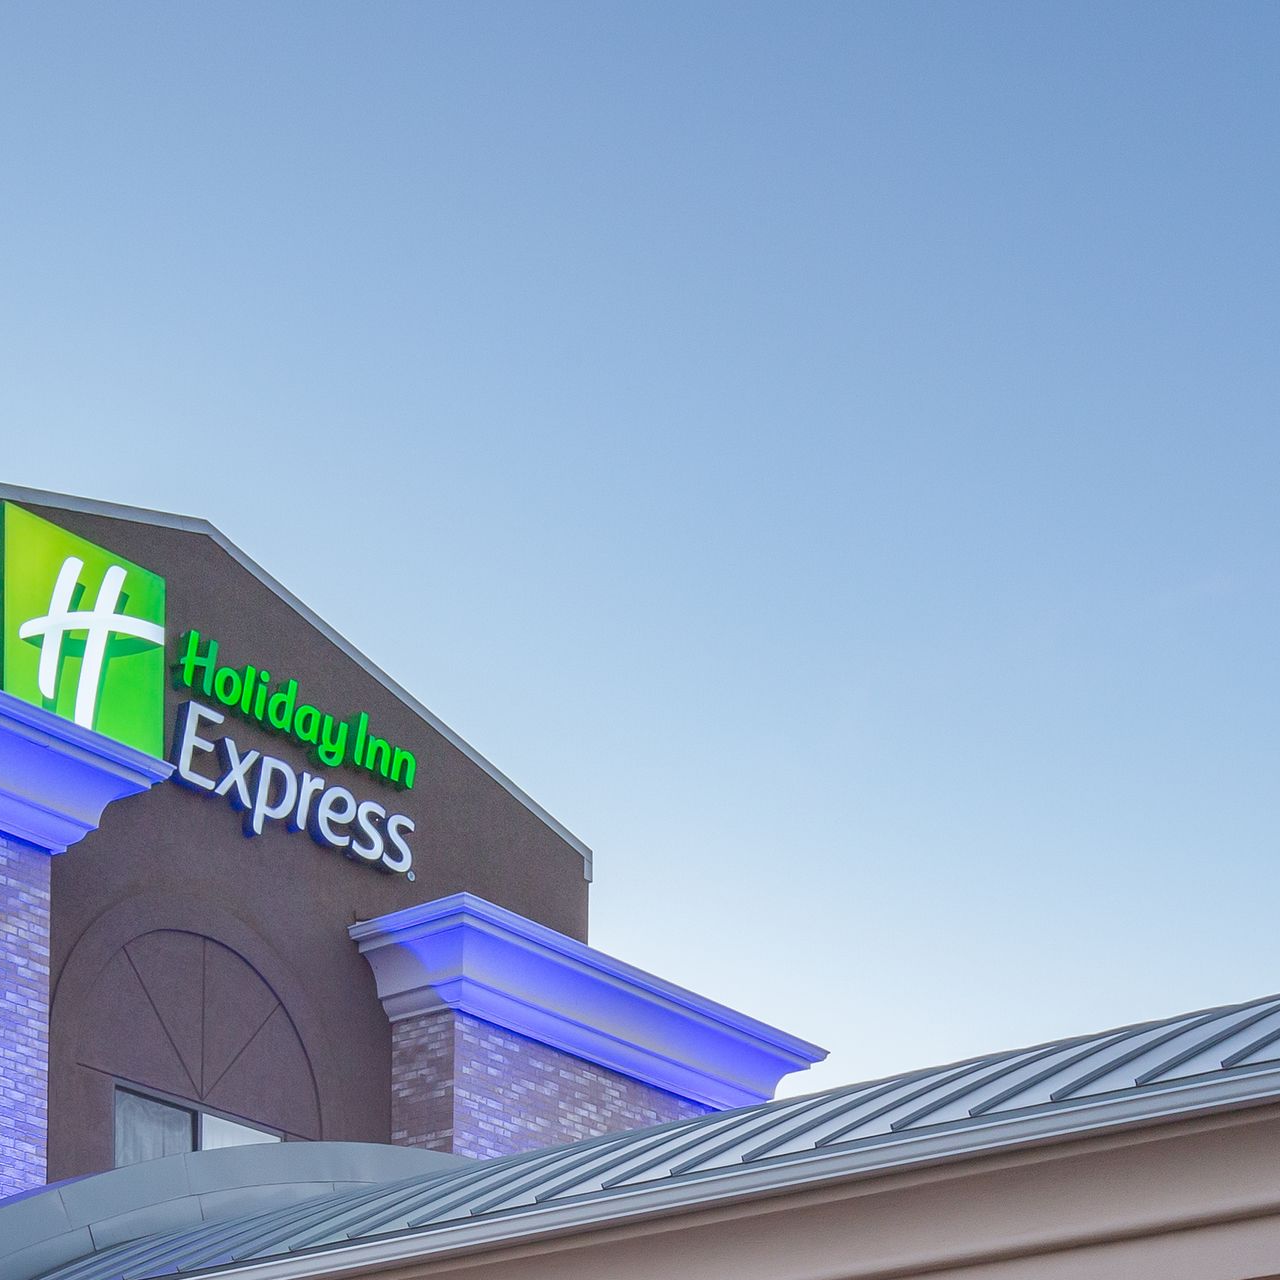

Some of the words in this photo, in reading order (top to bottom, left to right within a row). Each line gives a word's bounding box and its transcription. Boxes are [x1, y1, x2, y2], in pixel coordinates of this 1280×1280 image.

[178, 700, 416, 873] Express
[179, 629, 349, 768] Holiday
[353, 711, 417, 790] Inn
